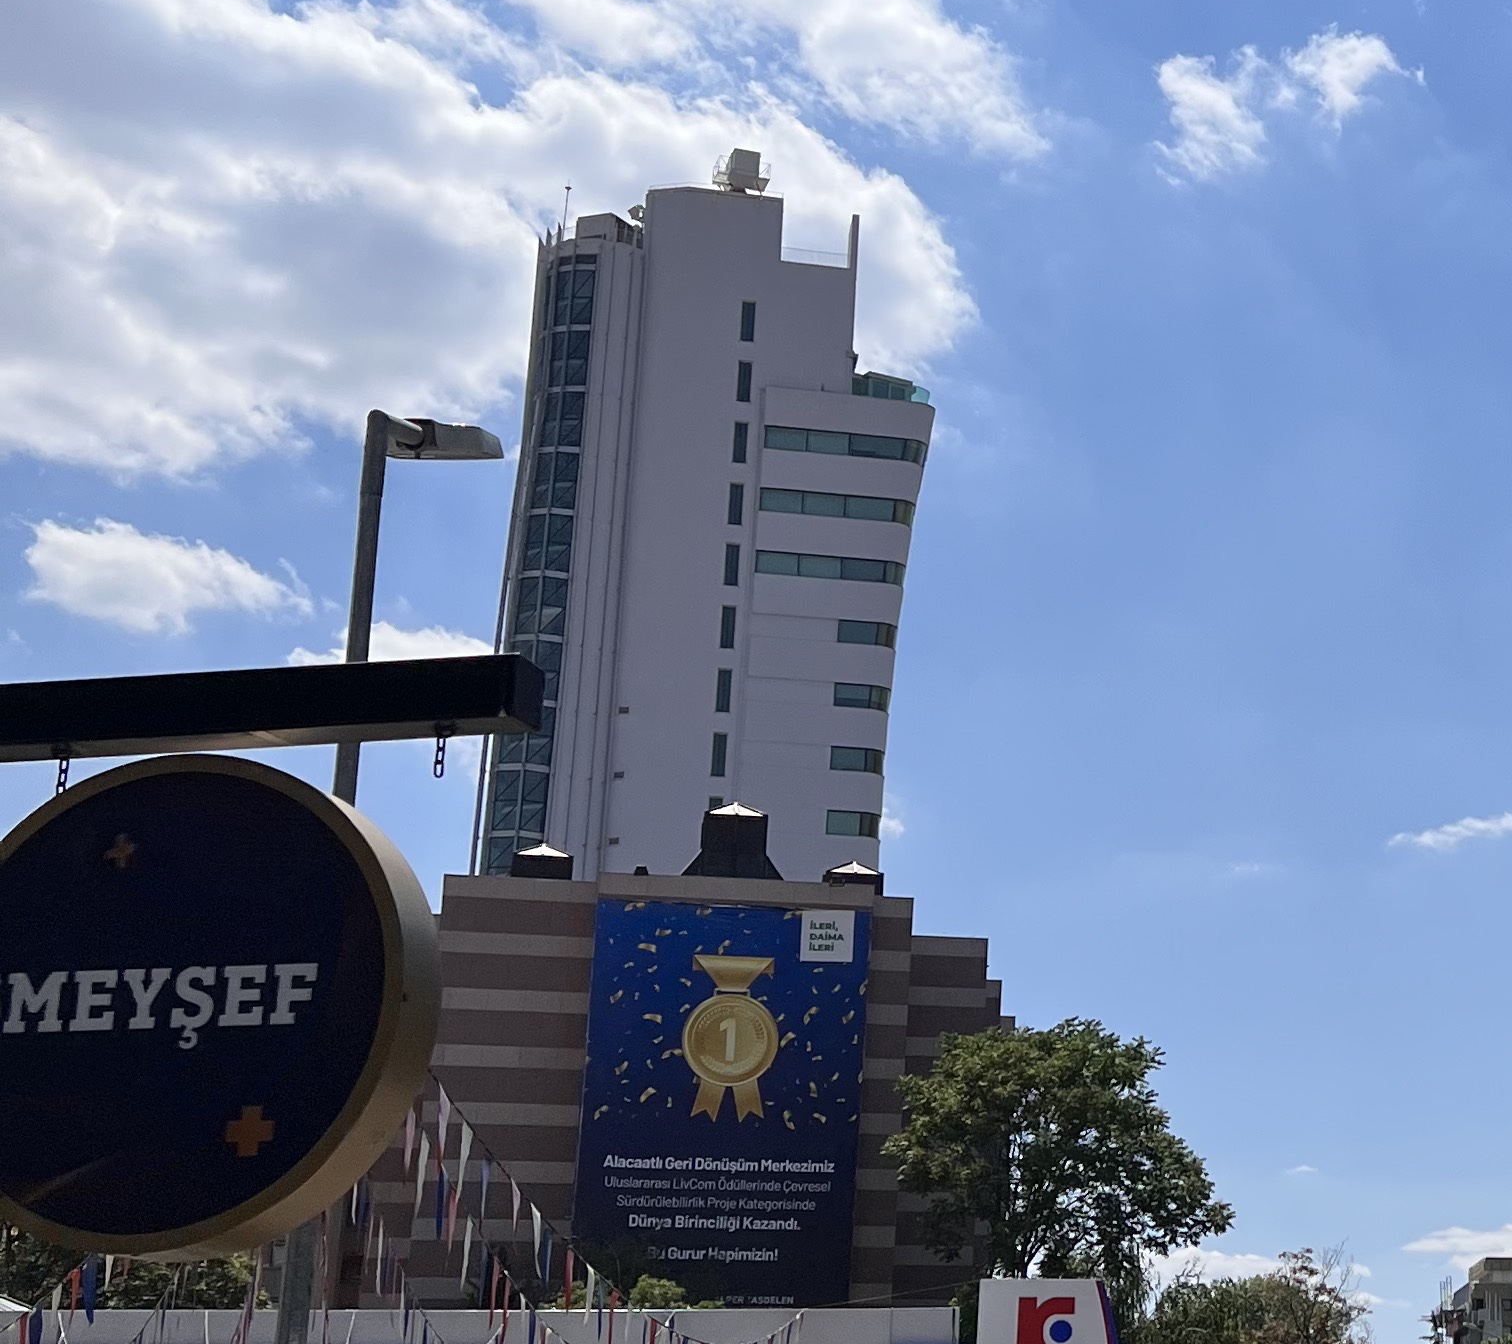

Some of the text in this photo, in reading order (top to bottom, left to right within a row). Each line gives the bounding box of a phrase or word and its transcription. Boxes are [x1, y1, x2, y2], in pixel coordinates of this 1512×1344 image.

[810, 931, 844, 941] DAİMA
[809, 941, 834, 951] İLERİ
[3, 963, 318, 1049] MEYŞEF
[719, 1017, 736, 1061] 1
[603, 1155, 835, 1174] Alacaatlı Geri Dönüşüm Merkezimiz
[604, 1176, 831, 1194] Uluslararası LivCom Ödüllerinde Çevresel
[707, 1197, 736, 1211] Proje
[738, 1198, 816, 1212] Kategorisinde
[628, 1214, 672, 1230] Dünya
[675, 1216, 740, 1232] Birinciliği
[668, 1246, 706, 1260] Gurur
